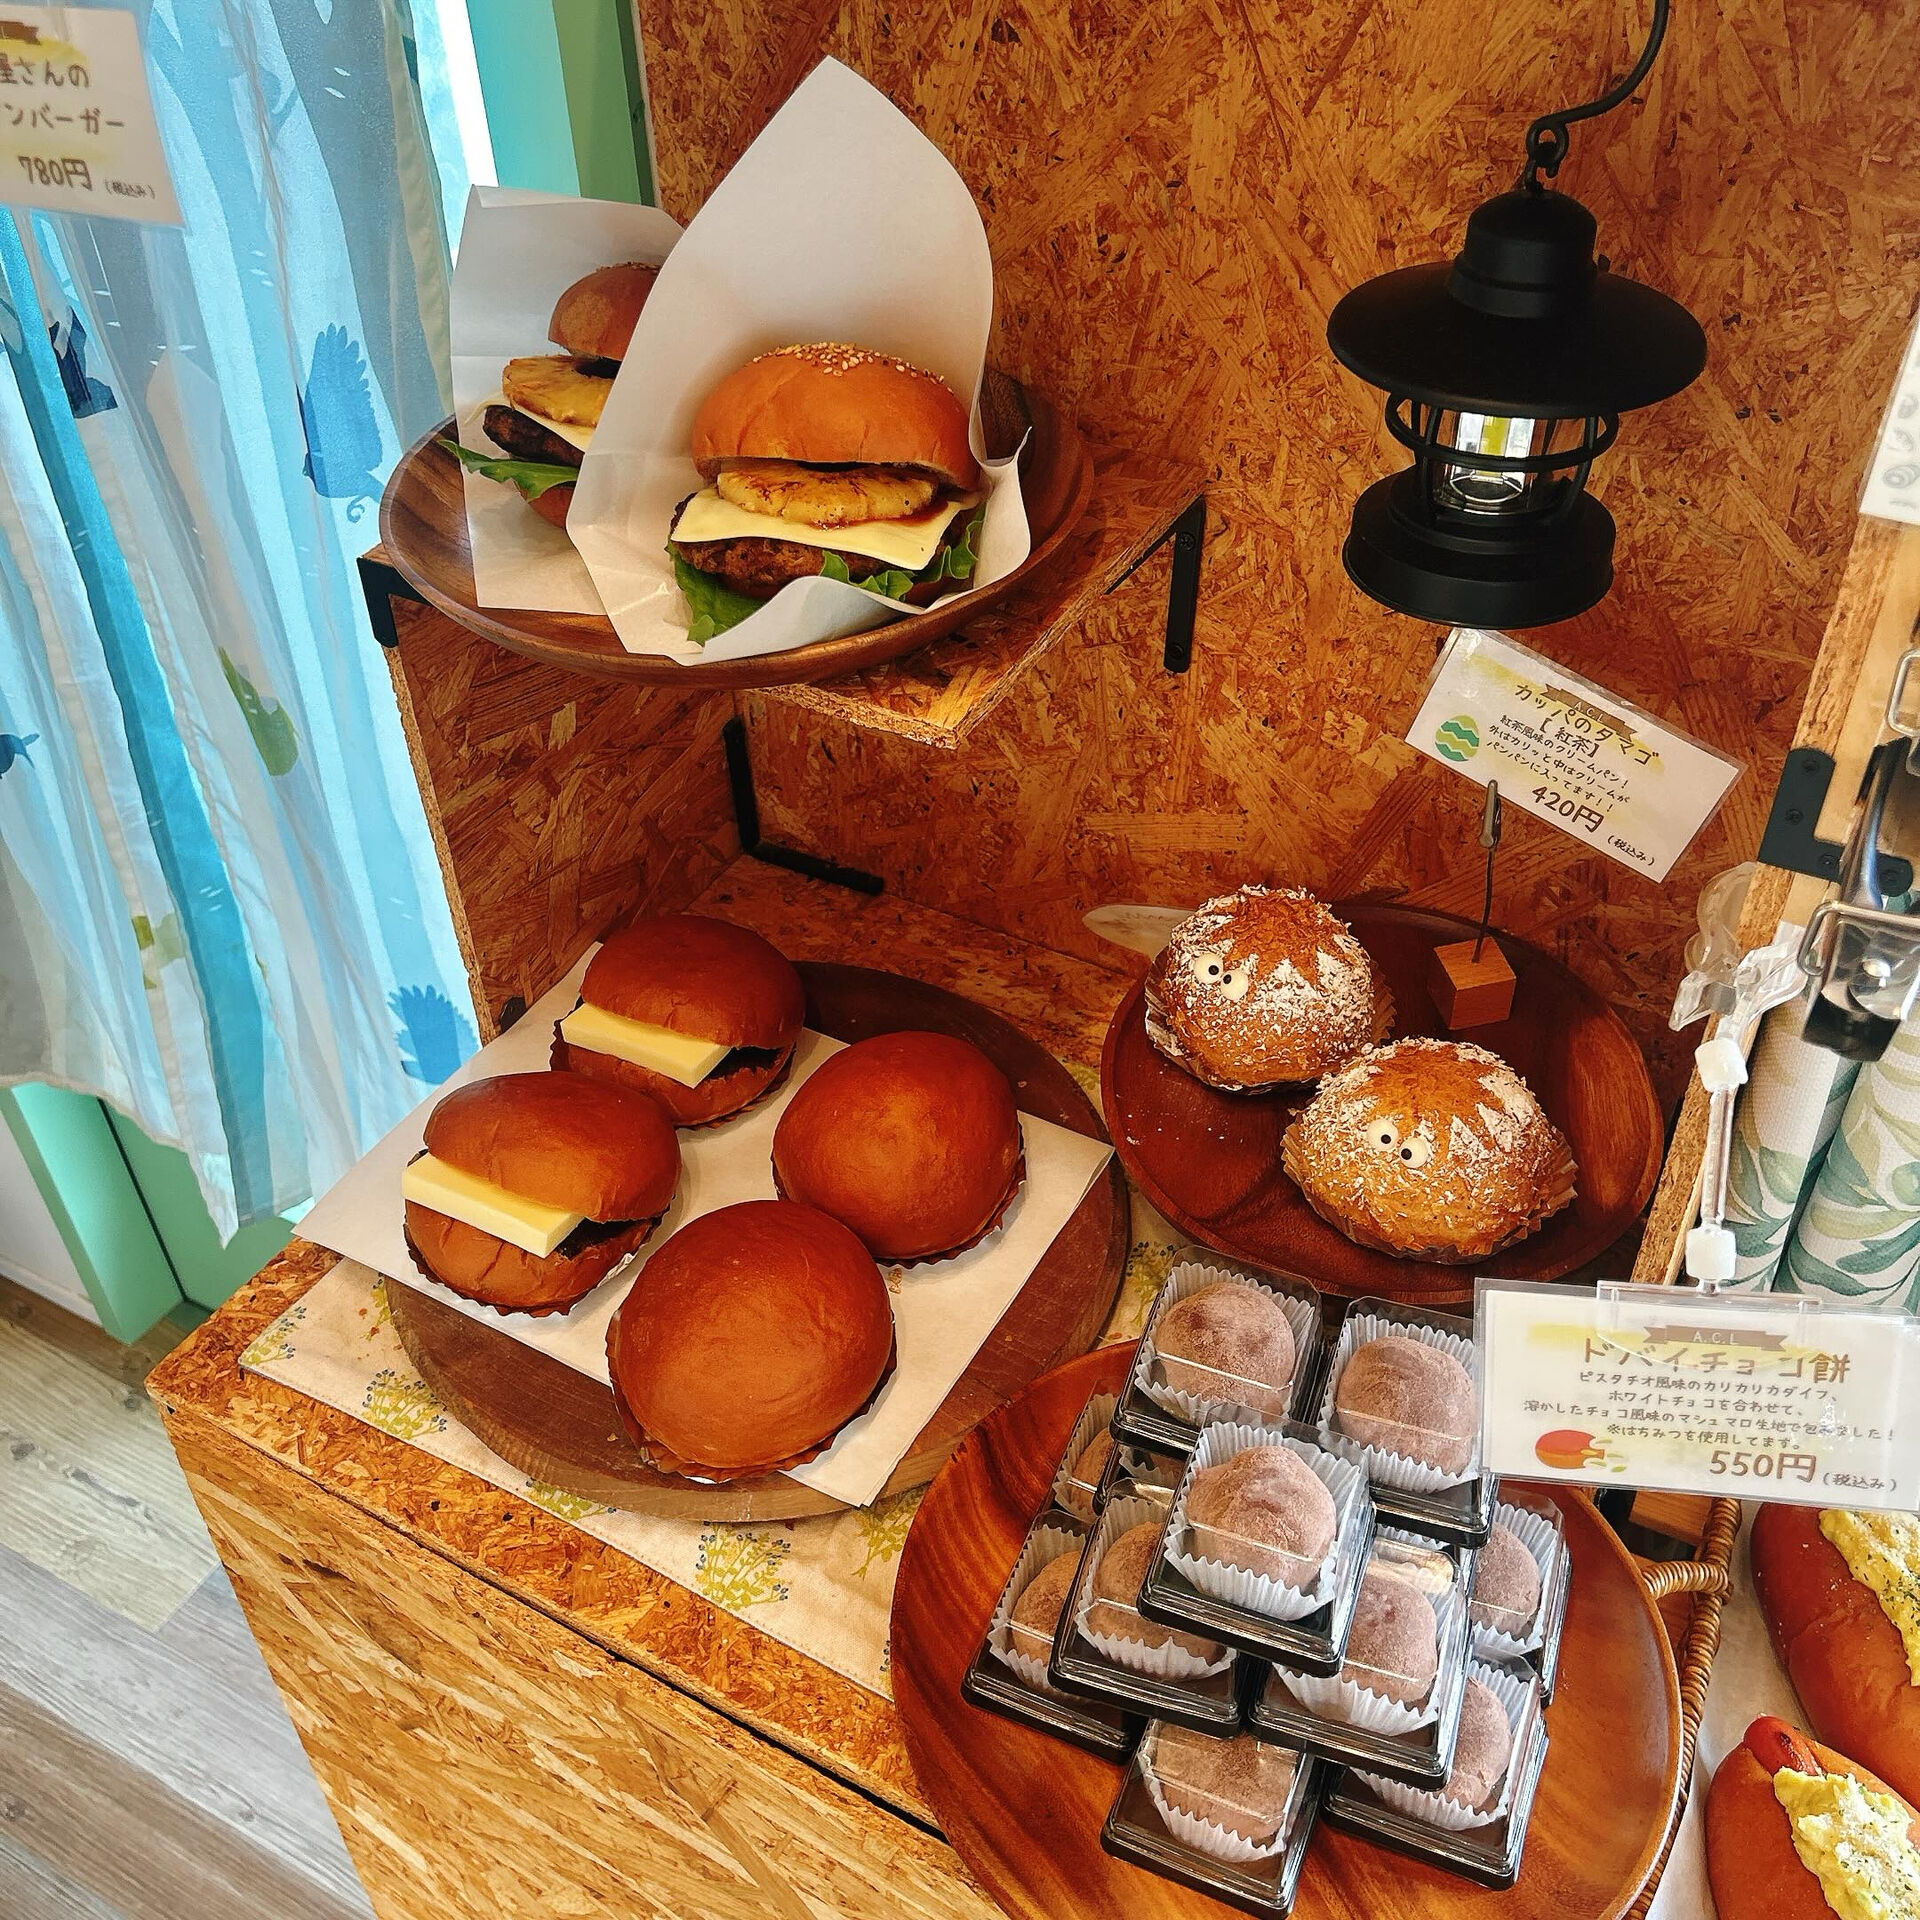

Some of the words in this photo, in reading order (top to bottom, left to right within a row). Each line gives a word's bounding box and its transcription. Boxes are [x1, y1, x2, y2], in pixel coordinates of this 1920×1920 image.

[18, 155, 93, 191] 780円
[1515, 684, 1659, 765] カッパのタマゴ
[1540, 717, 1600, 758] 【紅茶】
[1489, 725, 1630, 803] 外はカリッと中はクリームが
[1500, 715, 1628, 789] 紅茶風味のクリームパン！
[1486, 741, 1613, 812] パンパンに入ってます！！
[1532, 786, 1604, 833] 420円
[1607, 835, 1655, 866] （税込み）
[1584, 1338, 1851, 1384] ドバイチョコ餅
[1580, 1371, 1838, 1401] ピスタチオ風味のカリカリカダイフ、
[1609, 1390, 1804, 1416] ホワイトチョコを合わせて、
[1607, 1423, 1801, 1450] ※はちみつを使用してます。
[1710, 1449, 1817, 1483] 550円
[1823, 1472, 1897, 1492] （税込み）
